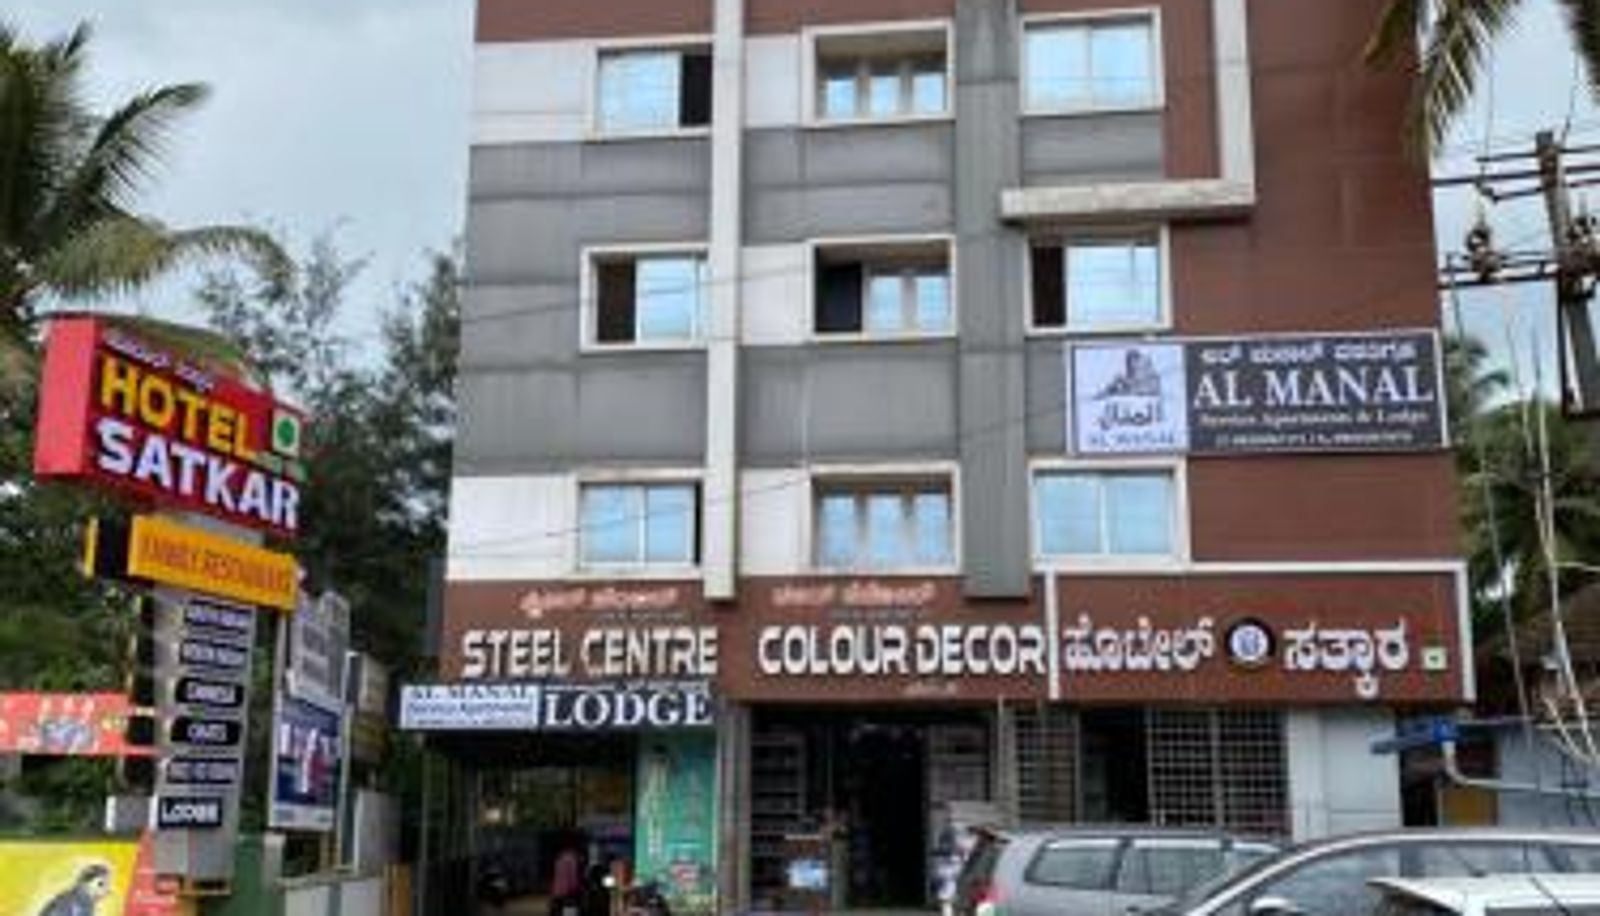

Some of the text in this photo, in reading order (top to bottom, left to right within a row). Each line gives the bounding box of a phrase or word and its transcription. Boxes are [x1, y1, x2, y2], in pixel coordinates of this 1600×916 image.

[102, 356, 257, 461] HOTEL
[1194, 364, 1434, 409] AL MANAL
[96, 417, 300, 530] SATKAR
[462, 626, 718, 678] STEEL CENTRE
[758, 625, 1046, 674] COLOUR DECOR
[544, 693, 712, 726] LODGE
